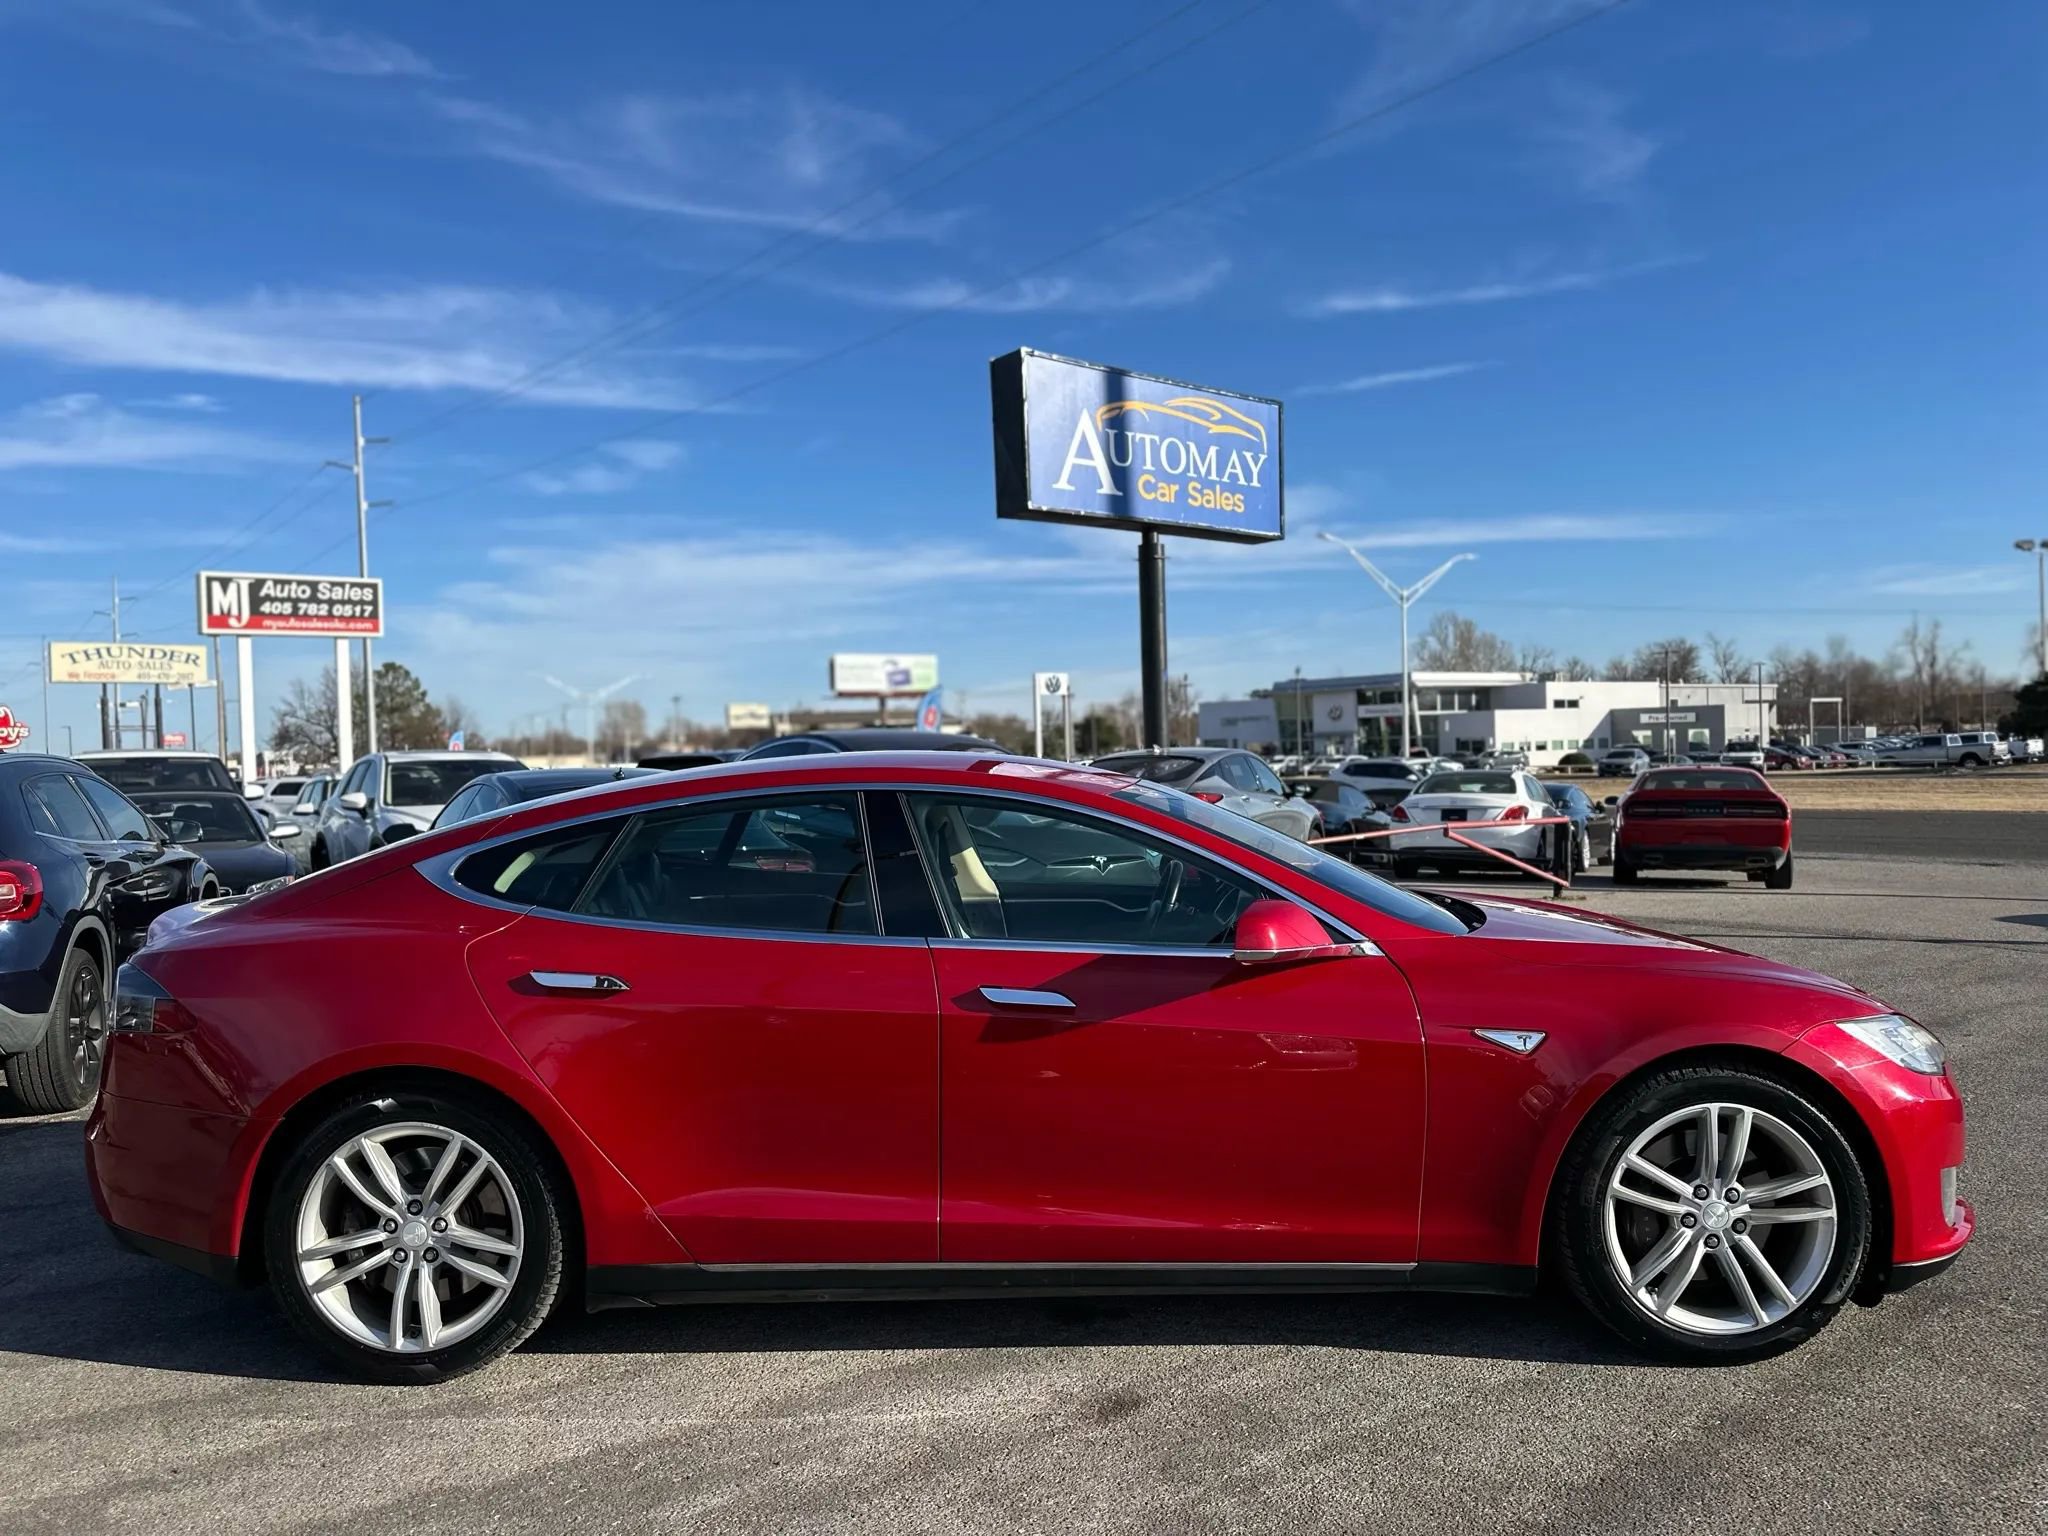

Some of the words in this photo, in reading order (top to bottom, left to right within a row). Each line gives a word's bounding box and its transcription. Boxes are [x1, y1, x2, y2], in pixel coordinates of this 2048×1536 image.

[1052, 408, 1268, 496] AUTOMAY
[1137, 474, 1180, 503] Car
[1188, 481, 1245, 513] Sales
[259, 580, 311, 599] Auto
[317, 582, 374, 601] Sales
[211, 578, 255, 628] MJ
[259, 602, 293, 615] 405
[297, 603, 328, 616] 782
[332, 604, 374, 617] 0517
[61, 646, 201, 668] THUNDER
[98, 660, 132, 671] AUTO
[135, 661, 173, 671] SALES
[83, 671, 116, 680] Finance
